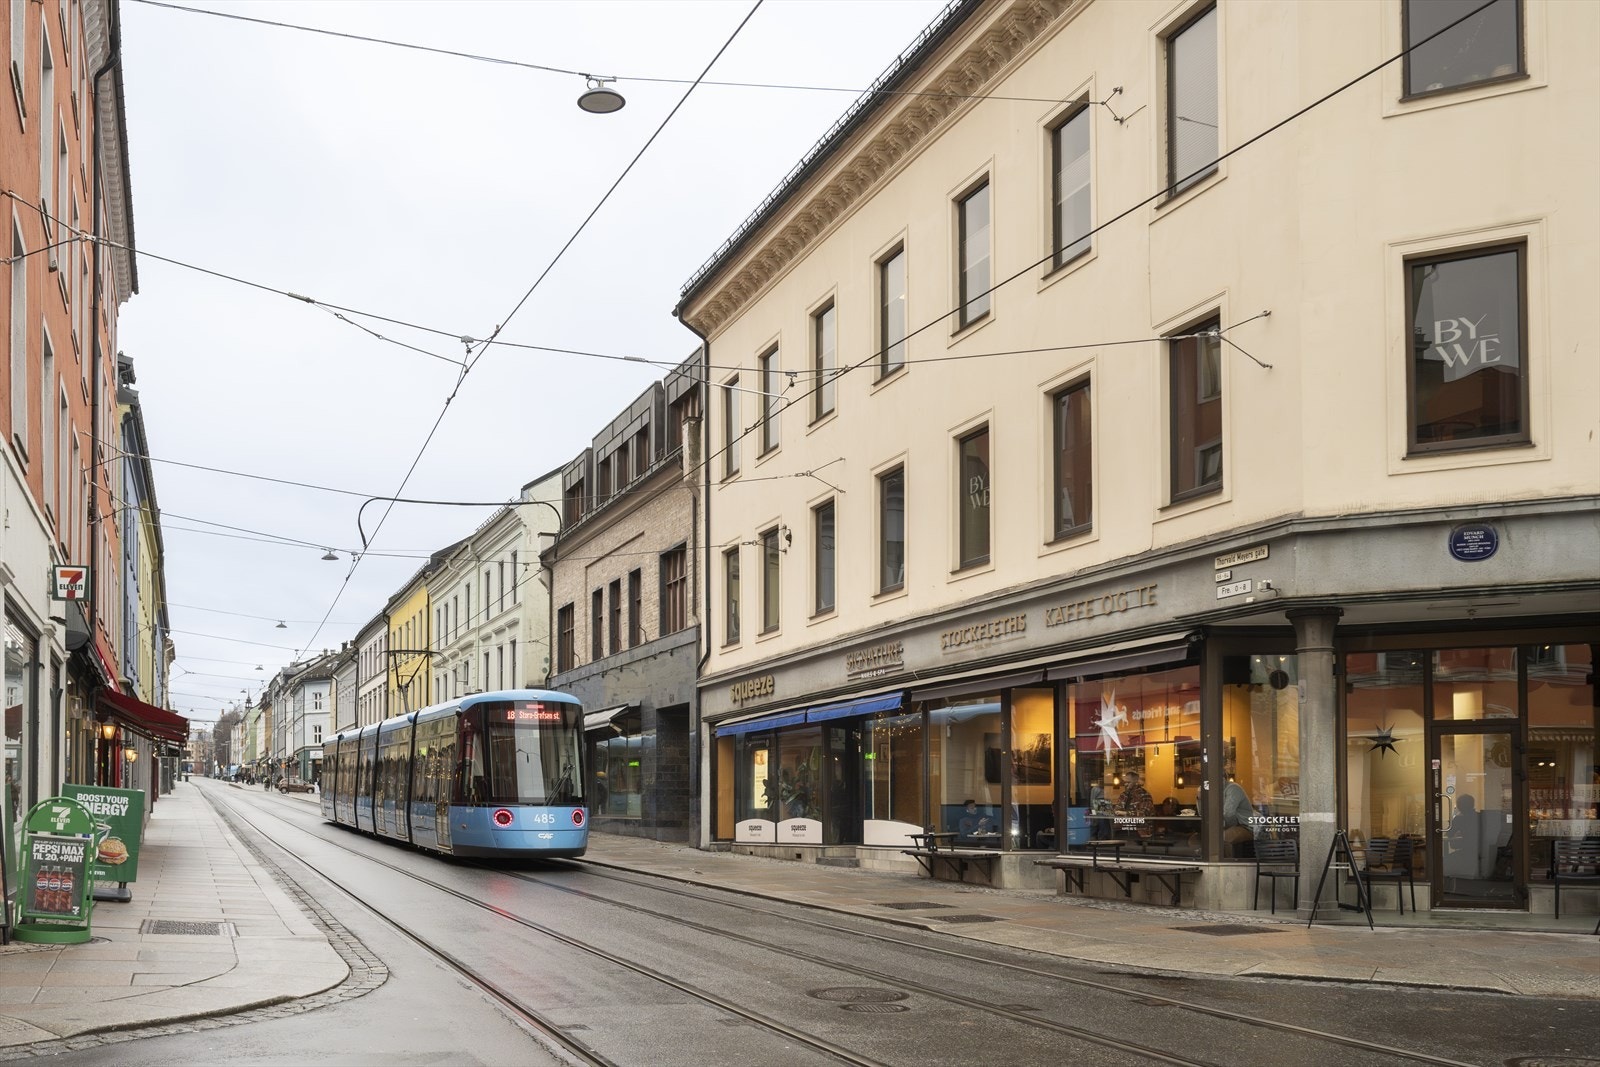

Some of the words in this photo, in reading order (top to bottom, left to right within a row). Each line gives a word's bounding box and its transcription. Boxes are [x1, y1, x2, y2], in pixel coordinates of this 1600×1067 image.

[1434, 313, 1487, 345] BY
[970, 471, 988, 494] BY
[1216, 554, 1236, 566] Thorvald
[1236, 551, 1254, 561] Meyers
[60, 570, 82, 599] 7
[941, 613, 1026, 649] STOCKFLETHS
[1044, 597, 1096, 628] KAFFE
[1100, 591, 1128, 615] OG
[1136, 583, 1158, 608] TE
[846, 640, 904, 672] SIGNATURE
[729, 674, 775, 707] squeeze
[507, 710, 516, 720] 18
[77, 793, 105, 802] BOOST
[105, 795, 129, 804] YOUR
[52, 806, 71, 830] 7
[79, 801, 129, 817] NERGY
[534, 813, 555, 824] 485
[33, 843, 60, 854] PEPSI
[61, 845, 85, 856] MAX
[33, 852, 43, 860] TIL
